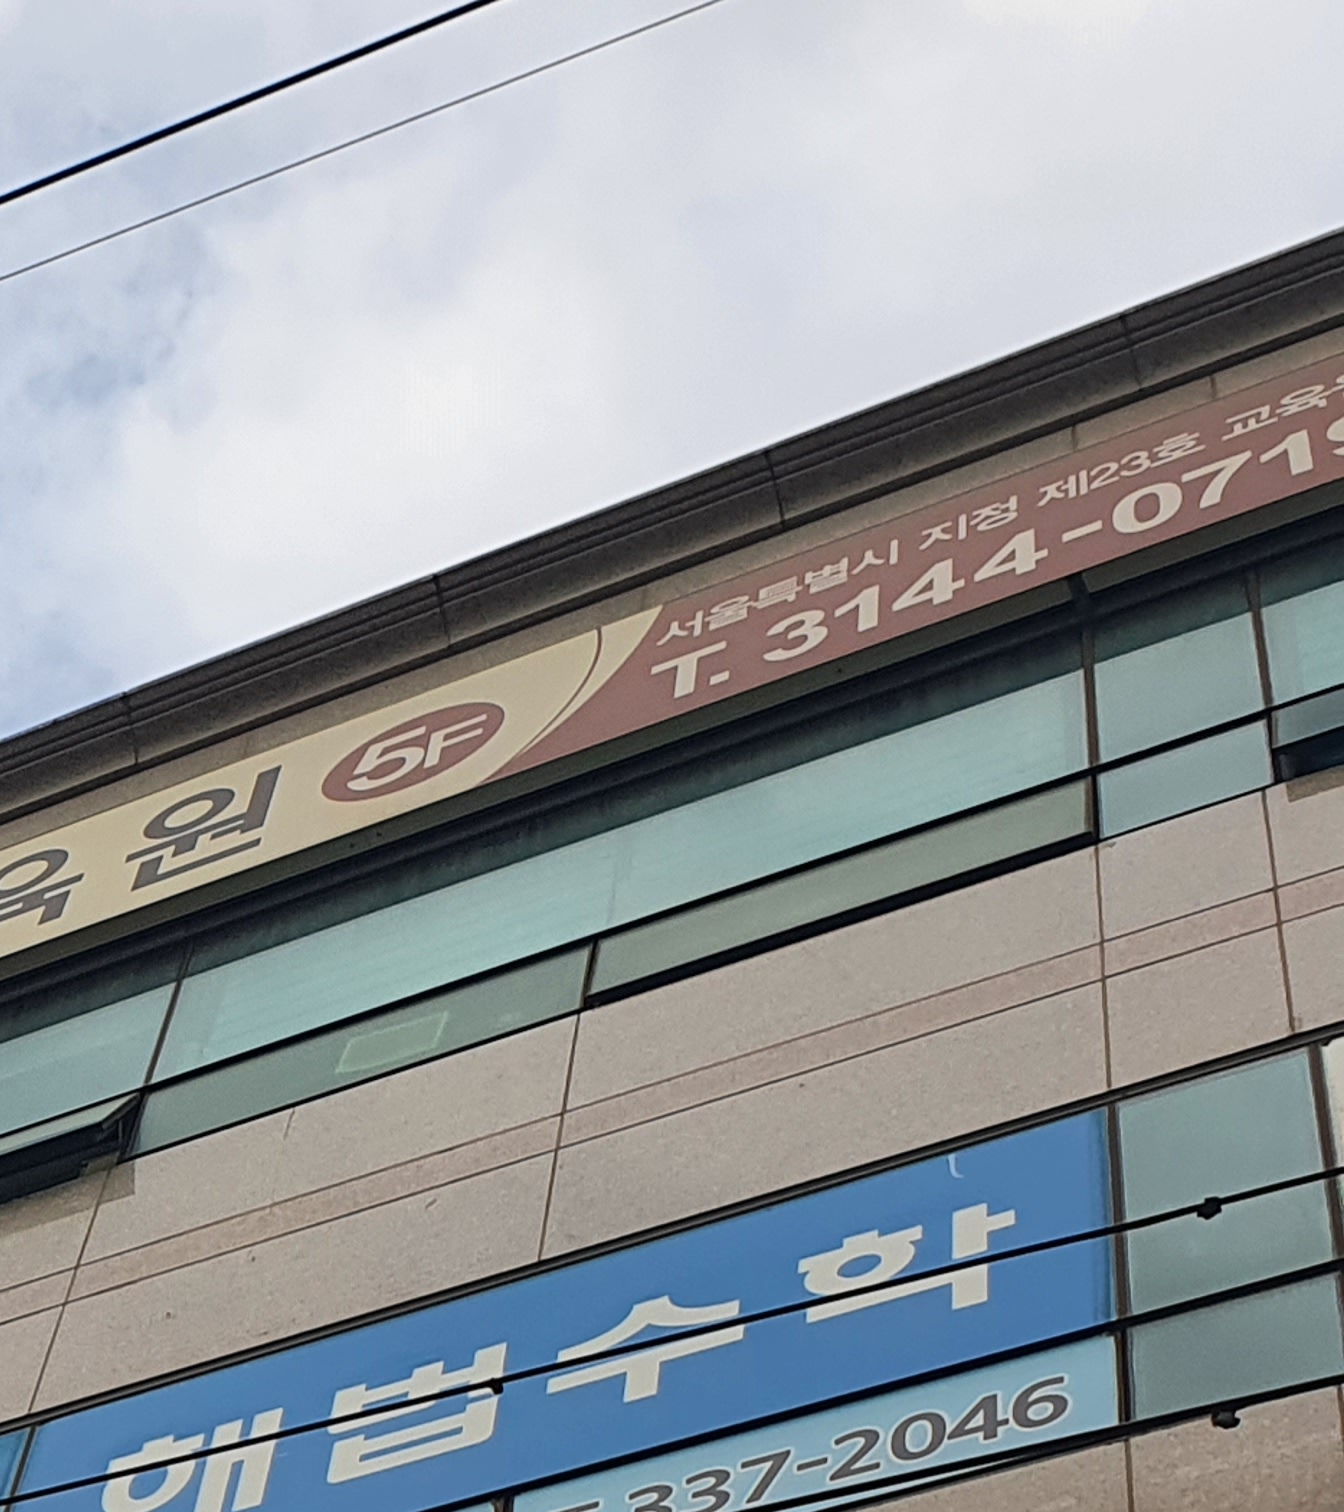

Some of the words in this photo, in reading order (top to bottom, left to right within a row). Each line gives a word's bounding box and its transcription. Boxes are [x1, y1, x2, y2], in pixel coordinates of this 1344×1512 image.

[655, 540, 900, 646] 서울특별시
[919, 495, 1020, 552] 지정
[1038, 433, 1205, 508] 제23호
[1221, 374, 1344, 441] 교육
[763, 416, 1344, 664] 3144-071
[346, 713, 487, 791] 5F
